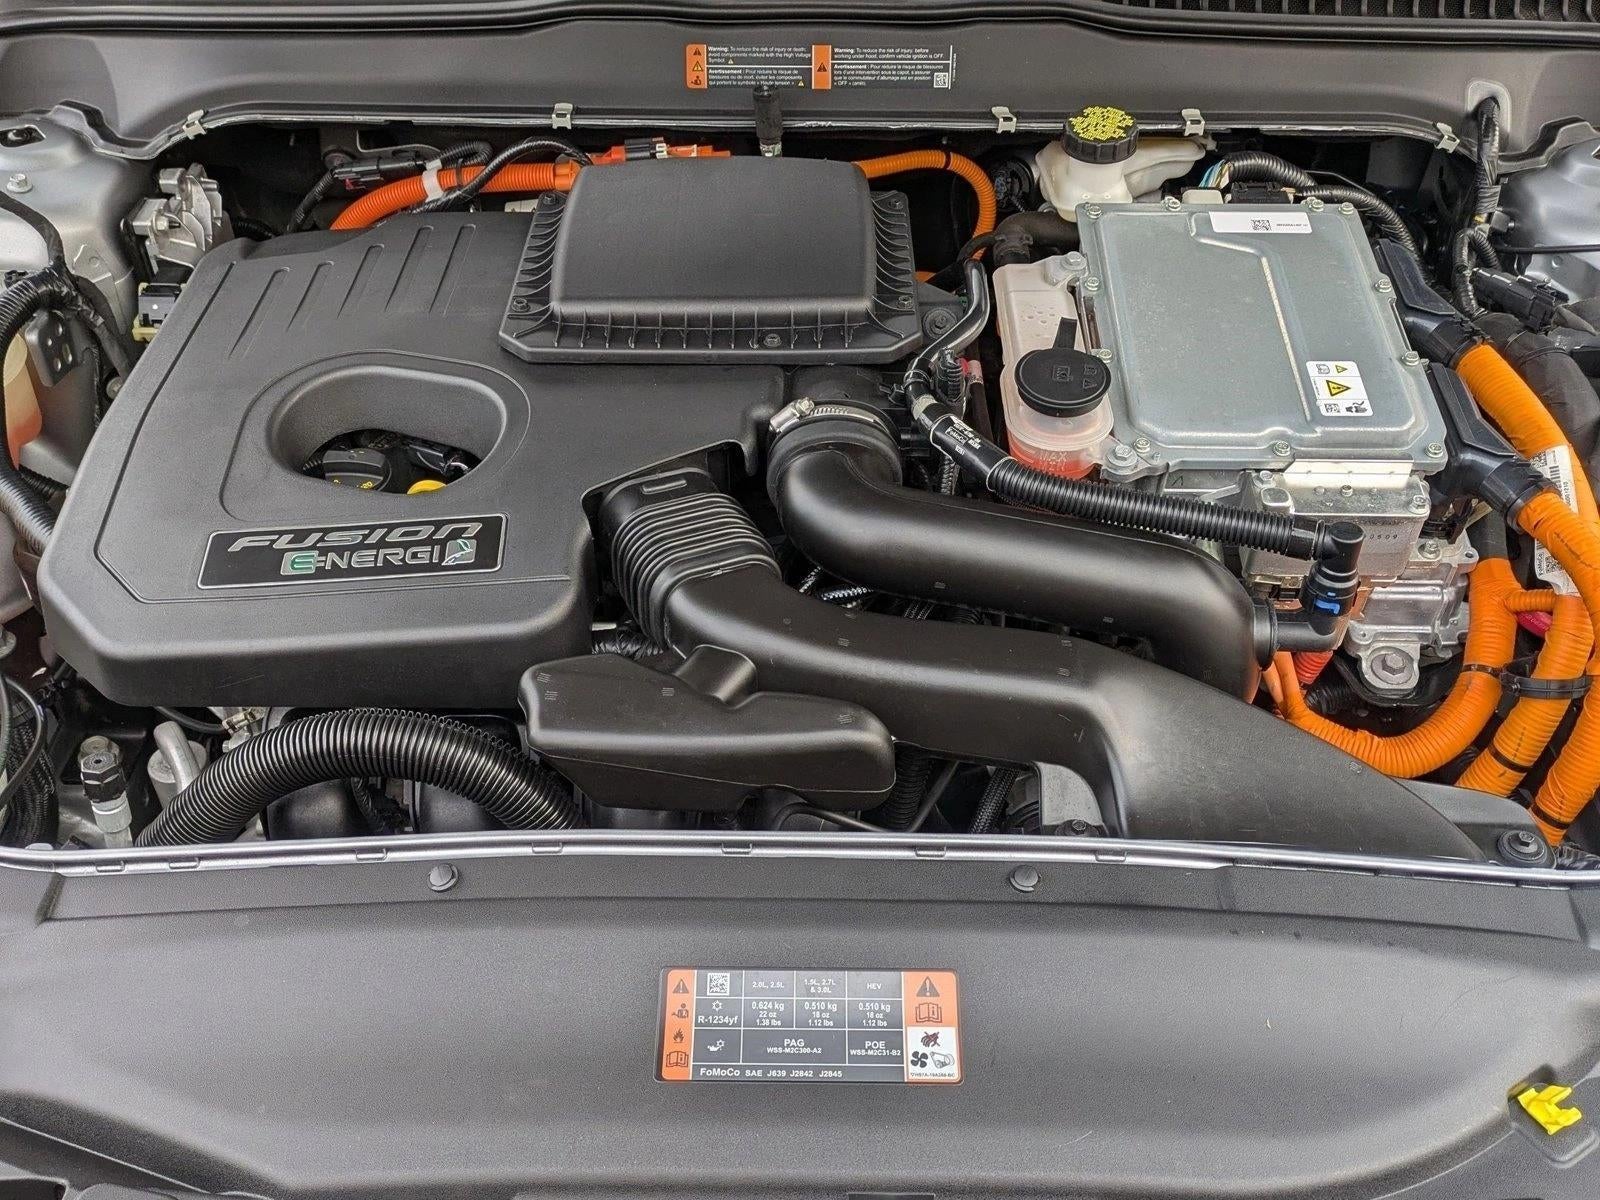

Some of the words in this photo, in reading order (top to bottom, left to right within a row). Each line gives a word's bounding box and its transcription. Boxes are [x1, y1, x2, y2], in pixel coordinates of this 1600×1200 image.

[227, 522, 483, 552] FUSION
[752, 1001, 773, 1010] 0.624
[774, 1001, 784, 1011] kg
[804, 1002, 826, 1010] 0.510
[827, 1002, 837, 1012] kg
[858, 1002, 879, 1010] 0.510
[880, 1002, 891, 1012] kg
[698, 1015, 738, 1026] R-1234yf
[784, 1038, 805, 1047] PAG
[865, 1041, 886, 1050] POE
[700, 1068, 740, 1076] FoMoCo
[790, 1070, 814, 1078] J2842
[818, 1070, 843, 1078] J2845
